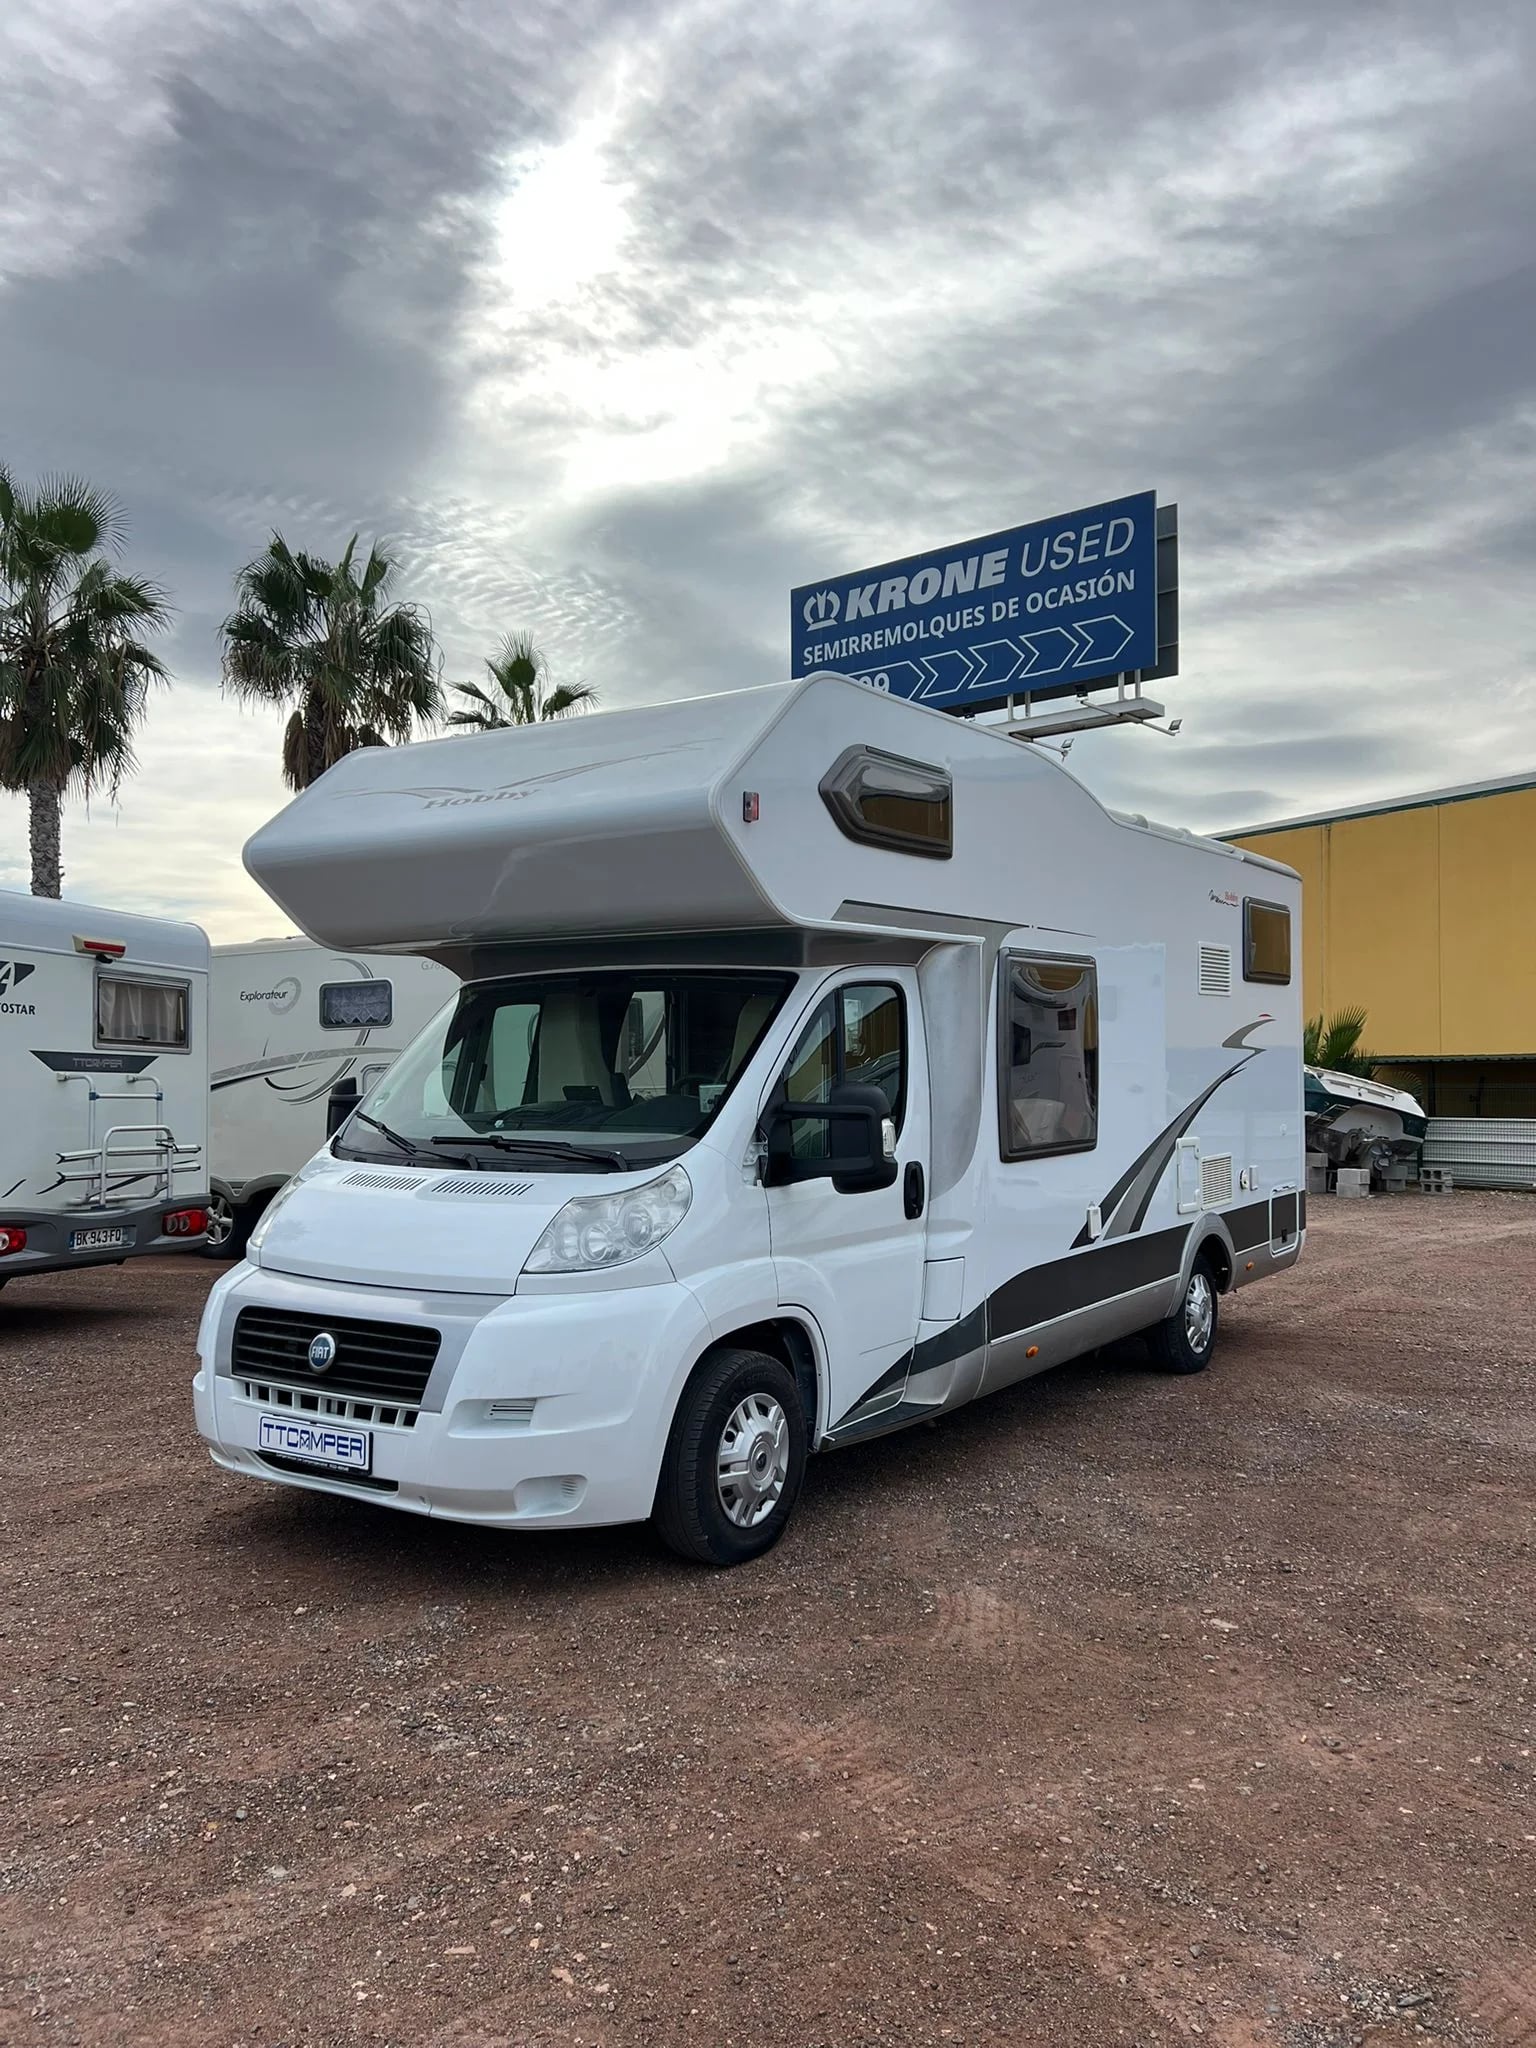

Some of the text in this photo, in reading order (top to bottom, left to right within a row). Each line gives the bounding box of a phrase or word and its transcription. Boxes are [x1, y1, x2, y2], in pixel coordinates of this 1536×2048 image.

[845, 517, 1135, 622] KRONE USED
[803, 568, 1135, 666] SEMIRREMOLQUES DE OCASIÓN
[423, 789, 540, 809] Hobby
[240, 990, 288, 1003] Explorateur
[0, 1002, 36, 1016] OSTAR
[311, 1346, 330, 1359] FIAT
[263, 1423, 362, 1459] TTCAMPER
